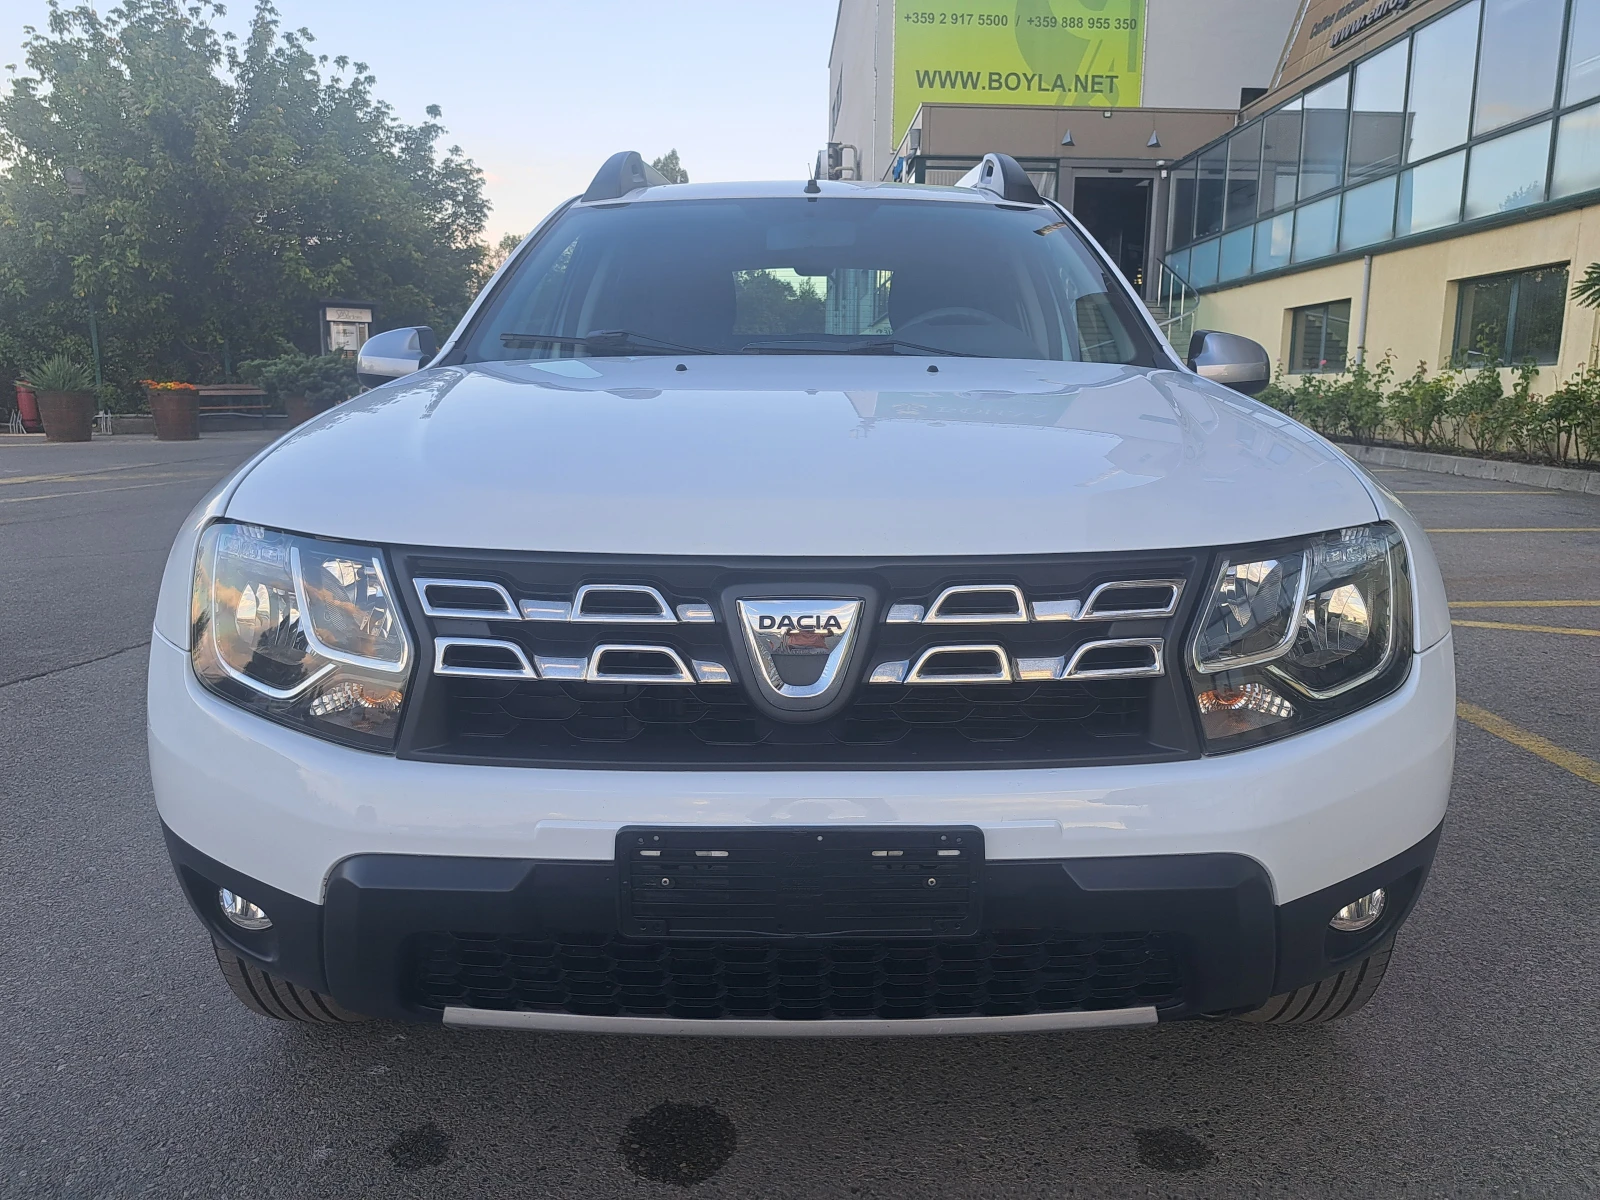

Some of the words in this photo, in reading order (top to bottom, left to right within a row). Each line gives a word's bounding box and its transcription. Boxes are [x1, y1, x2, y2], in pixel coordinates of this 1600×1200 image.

[904, 12, 935, 24] +359
[939, 13, 947, 25] 2
[951, 13, 974, 25] 917
[978, 14, 1009, 27] 5500
[1027, 16, 1057, 28] +359
[1061, 17, 1084, 29] 888
[1087, 18, 1111, 30] 955
[1114, 18, 1137, 30] 350
[915, 69, 1119, 94] WWW.BOYLA.NET
[758, 615, 842, 630] DACIA
